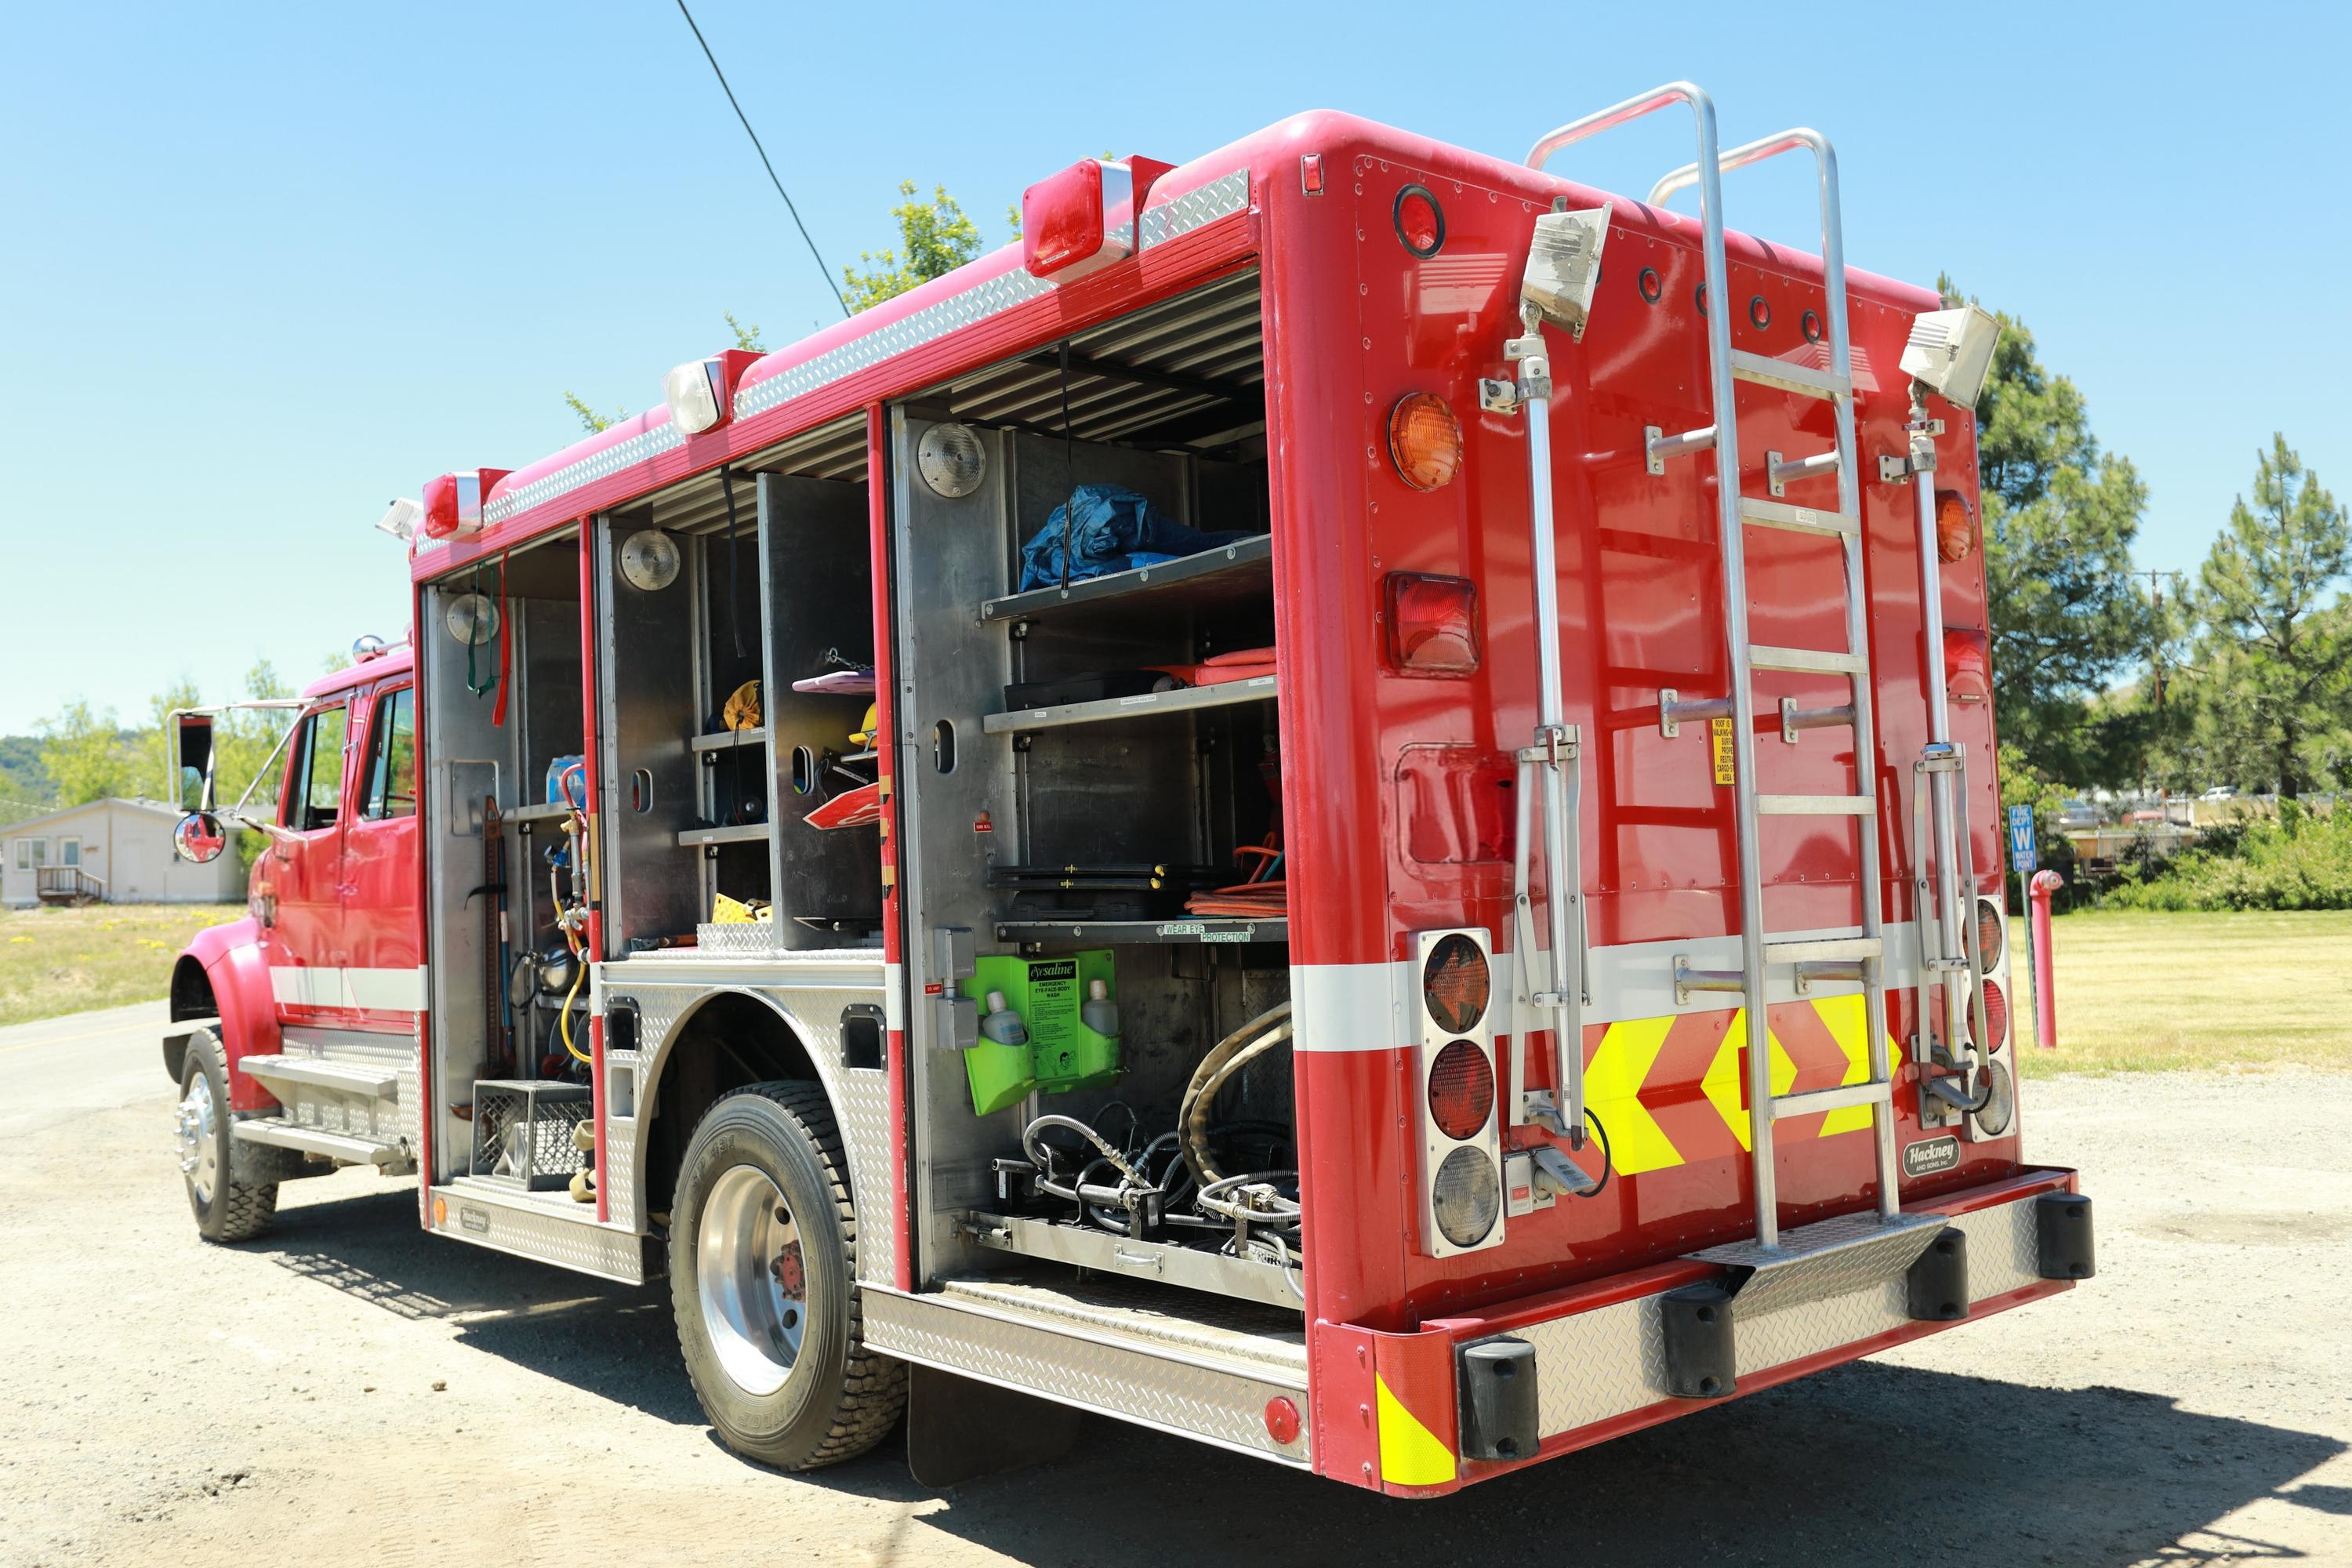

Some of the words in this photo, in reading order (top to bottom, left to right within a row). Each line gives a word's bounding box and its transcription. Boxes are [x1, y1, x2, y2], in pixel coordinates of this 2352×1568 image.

[1722, 773, 1732, 782] AREA
[2012, 808, 2029, 817] FIRE
[2013, 817, 2031, 826] DEPT
[2013, 827, 2031, 851] W
[2015, 851, 2033, 860] WATER
[2016, 860, 2033, 869] POINT
[1166, 925, 1187, 934] WEAR
[1190, 925, 1203, 934] EYE
[1202, 933, 1249, 942] PROTECTION
[1031, 963, 1073, 981] eyesaline
[1909, 1144, 1954, 1164] Hackney
